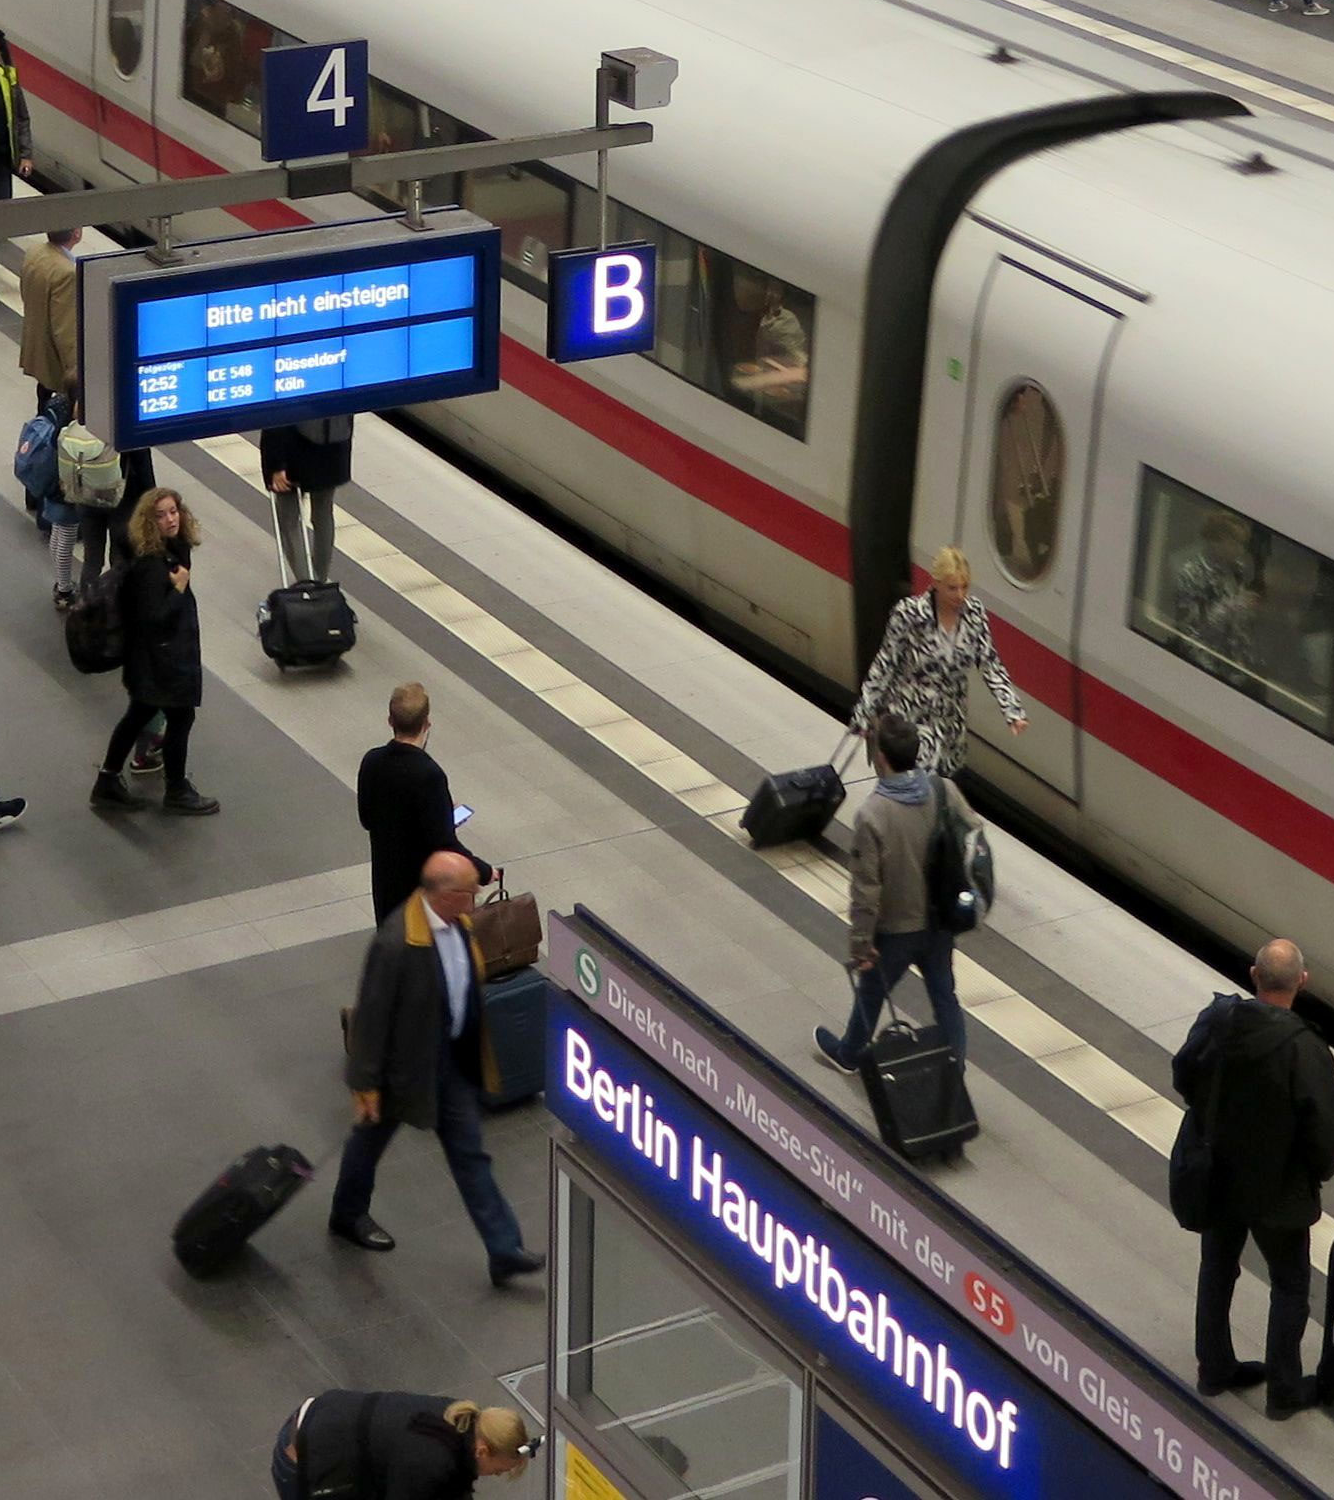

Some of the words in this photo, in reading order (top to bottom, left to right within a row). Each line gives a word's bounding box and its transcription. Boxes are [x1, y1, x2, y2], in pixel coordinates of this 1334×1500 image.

[306, 47, 355, 128] 4
[206, 304, 254, 329] Bitte
[259, 296, 307, 321] nicht
[313, 283, 410, 313] einsteigen
[593, 253, 645, 335] B
[275, 348, 347, 373] Düsseldorf
[139, 375, 178, 393] 12:52
[207, 367, 227, 383] ICE
[230, 364, 253, 380] 548
[275, 376, 305, 393] Köln
[139, 395, 178, 414] 12:52
[207, 388, 227, 403] ICE
[230, 385, 253, 400] 558
[578, 953, 598, 995] S
[607, 978, 667, 1051] Direkt
[671, 1034, 719, 1093] nach
[869, 1199, 908, 1251] mit
[914, 1238, 955, 1286] der
[1021, 1323, 1068, 1382] von
[1078, 1367, 1142, 1442] Gleis
[1153, 1426, 1184, 1474] 16
[565, 1027, 679, 1180] Berlin
[691, 1135, 1019, 1470] Hauptbahnhof
